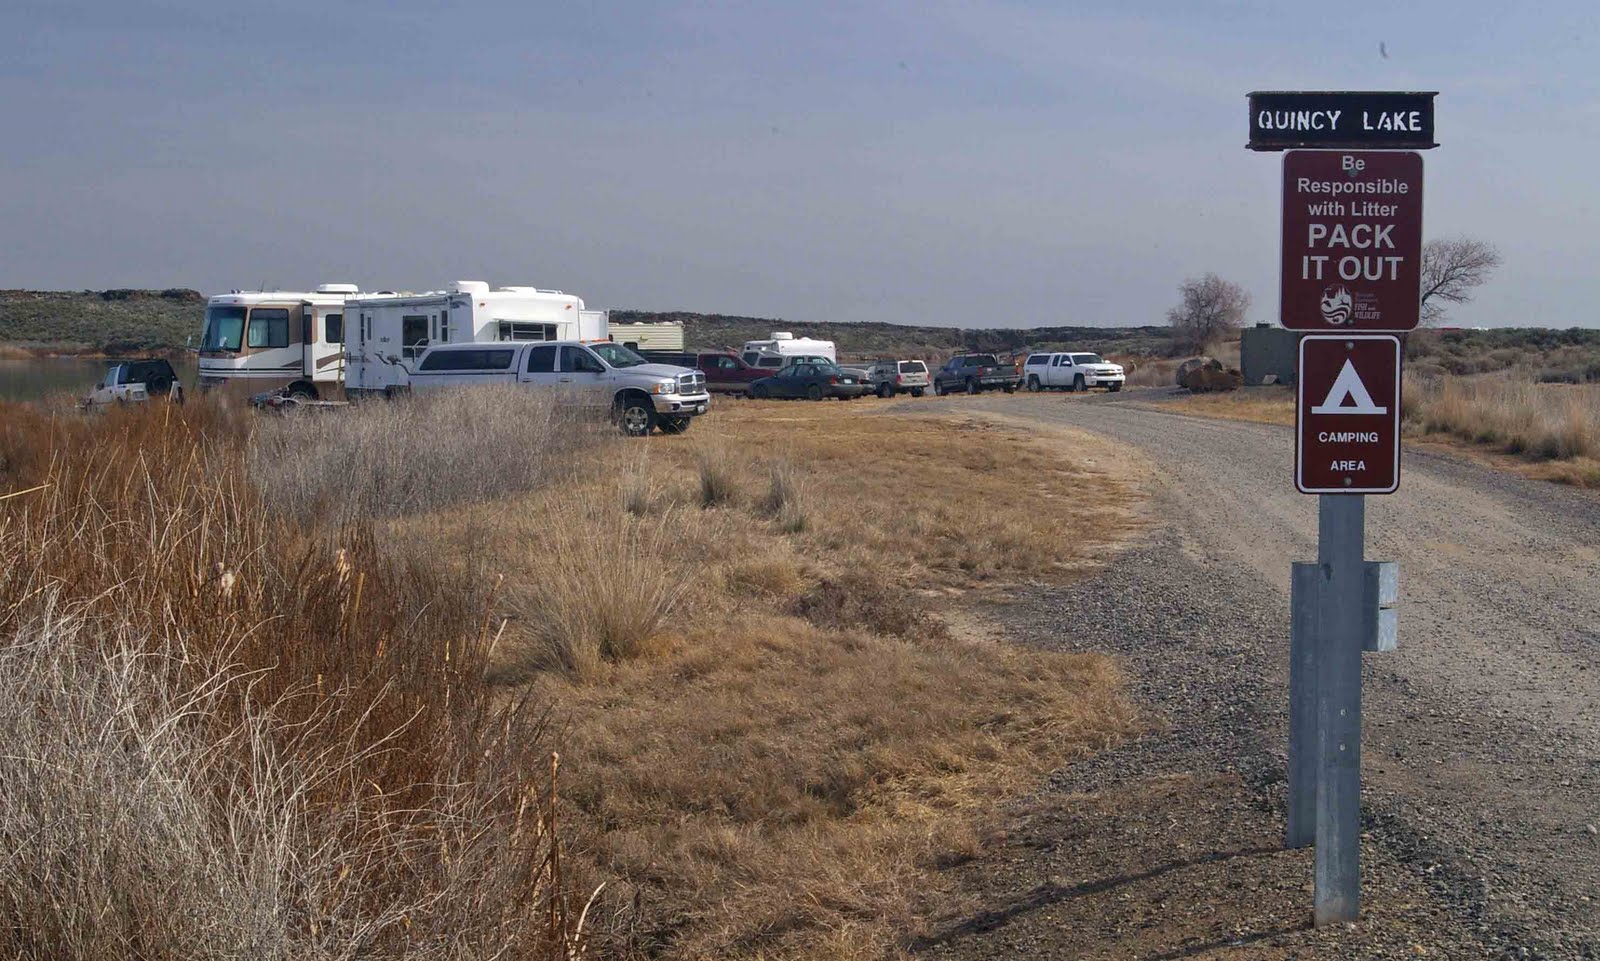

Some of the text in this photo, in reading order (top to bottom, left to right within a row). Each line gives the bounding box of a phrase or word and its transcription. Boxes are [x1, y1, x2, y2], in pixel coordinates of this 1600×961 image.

[1258, 110, 1422, 132] QUINCY LAKE
[1342, 155, 1366, 171] Be
[1297, 177, 1409, 197] Responsible
[1308, 201, 1399, 217] with Litter
[1308, 223, 1396, 249] PACK
[1302, 255, 1404, 281] IT OUT
[1318, 432, 1379, 443] CAMPING
[1330, 460, 1366, 471] AREA
